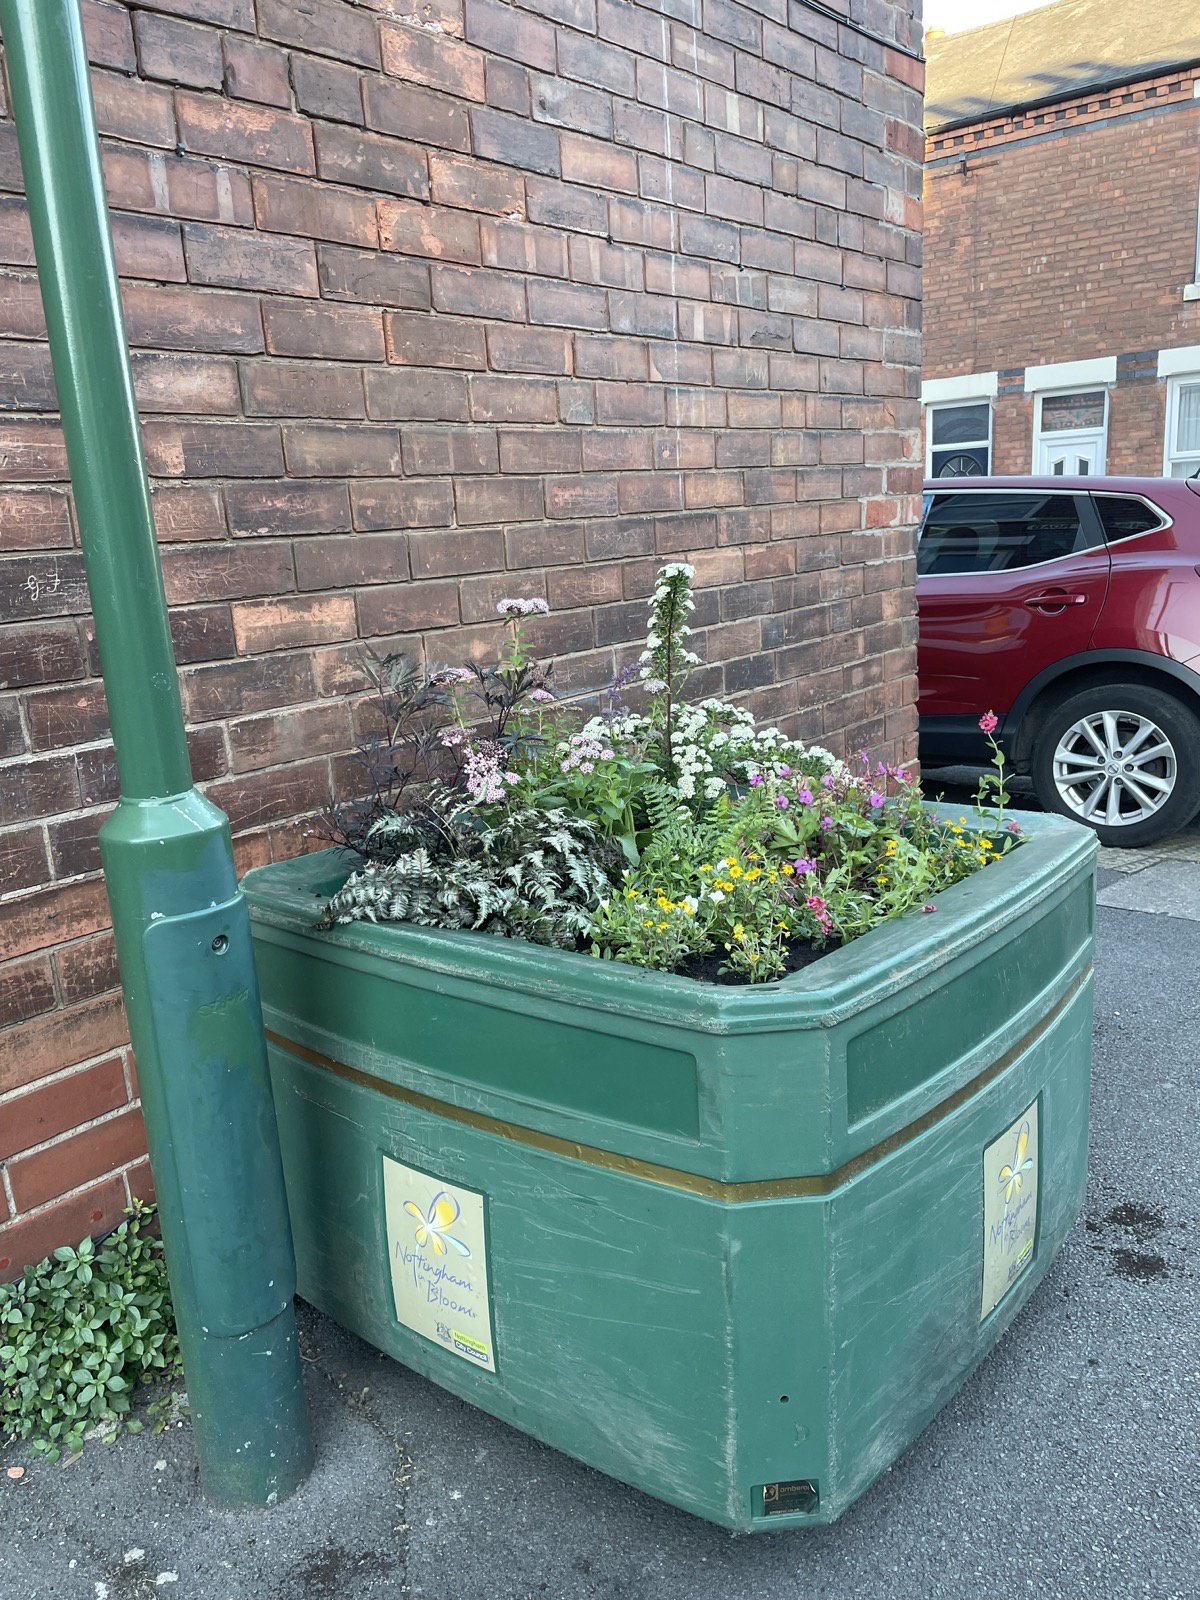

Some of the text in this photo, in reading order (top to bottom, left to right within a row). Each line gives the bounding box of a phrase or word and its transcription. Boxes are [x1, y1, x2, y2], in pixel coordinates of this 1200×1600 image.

[395, 1241, 473, 1291] Nottingham
[427, 1280, 473, 1318] Bloom
[454, 1331, 487, 1352] Nottingham
[455, 1341, 467, 1352] City
